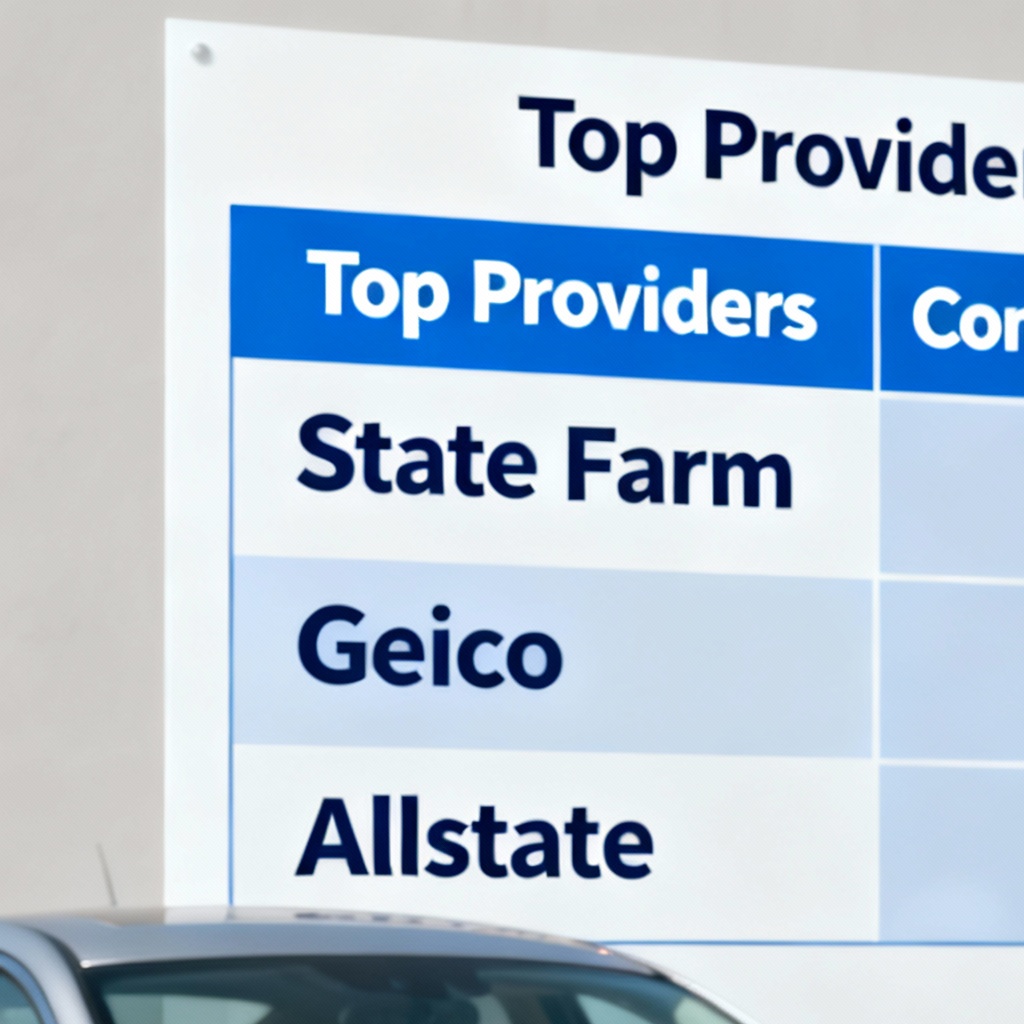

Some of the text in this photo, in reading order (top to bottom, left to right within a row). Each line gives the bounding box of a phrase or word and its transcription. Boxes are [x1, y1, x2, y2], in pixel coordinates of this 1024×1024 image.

[518, 95, 678, 197] Top
[306, 249, 818, 342] Top Providers
[297, 412, 792, 509] State Farm
[297, 604, 564, 691] Geico
[295, 794, 654, 880] Allstate
